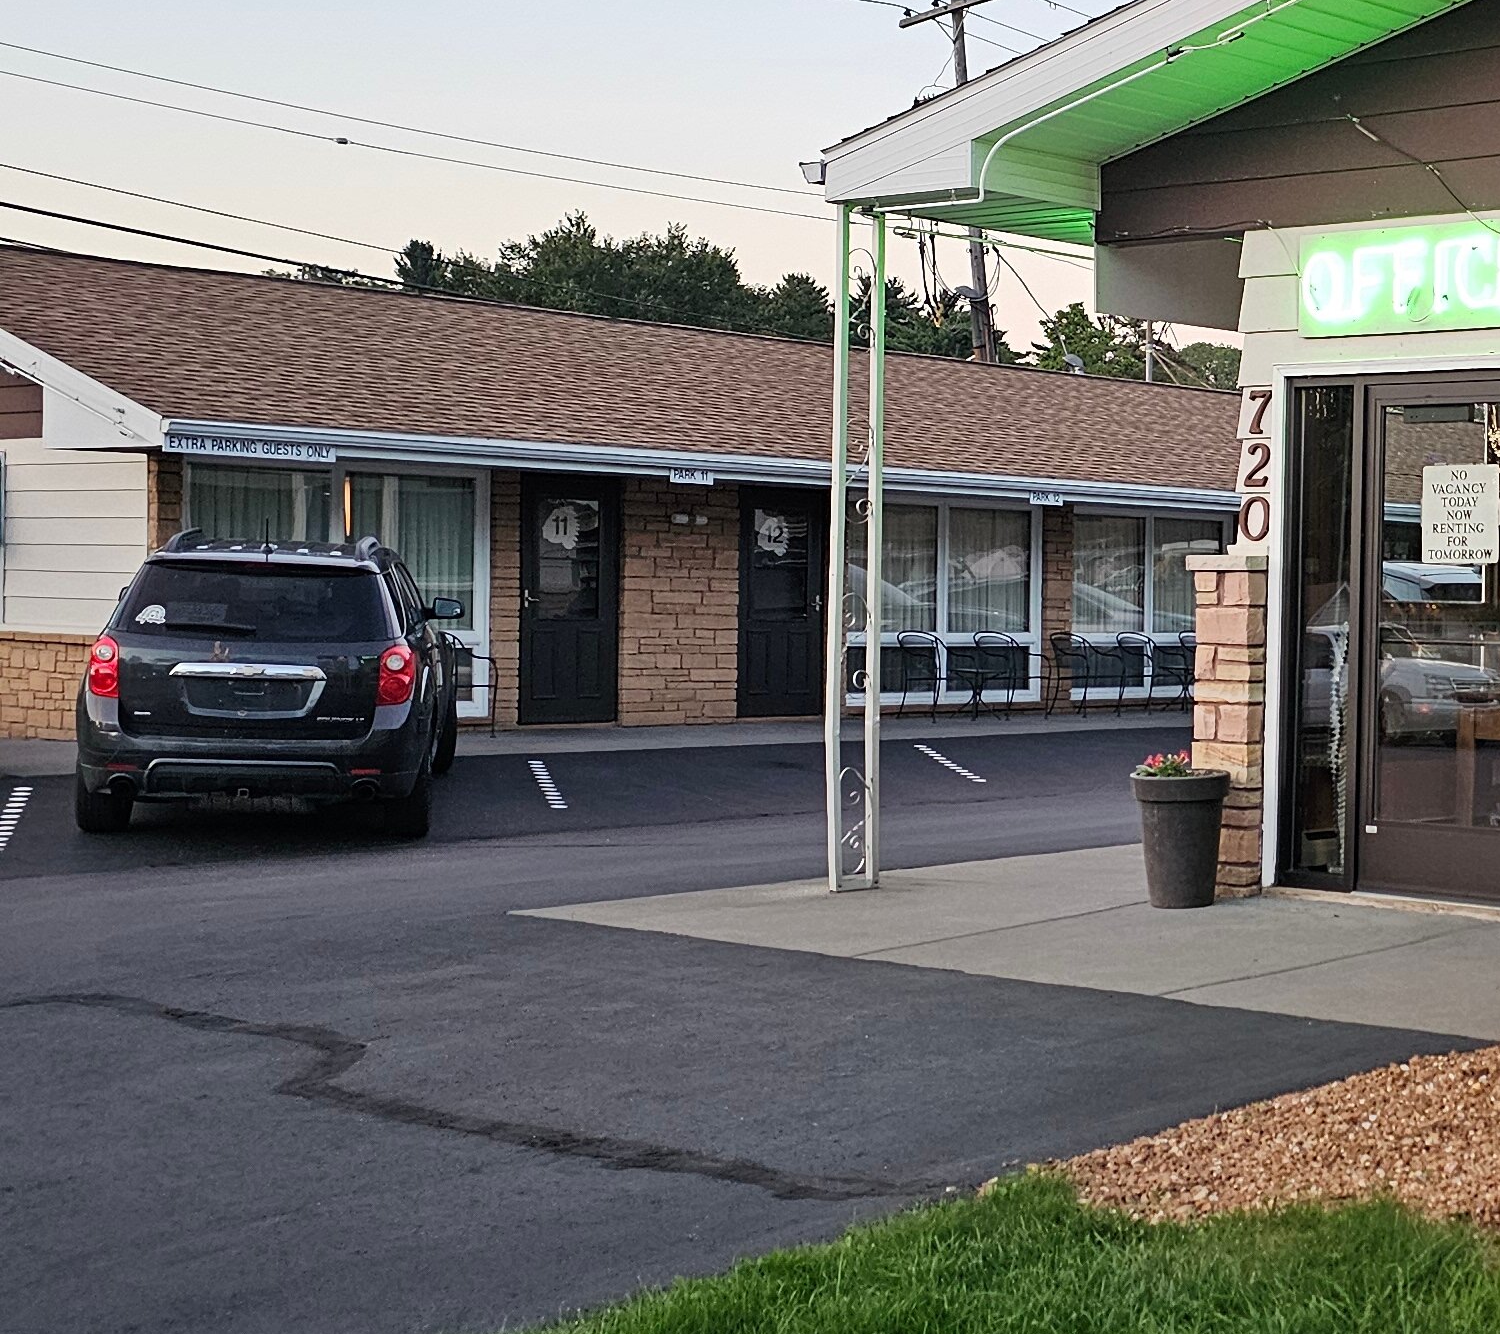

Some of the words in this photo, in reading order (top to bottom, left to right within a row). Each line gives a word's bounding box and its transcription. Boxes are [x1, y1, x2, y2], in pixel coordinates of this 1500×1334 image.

[169, 435, 206, 451] EXTRA
[211, 438, 257, 454] PARKING
[262, 441, 302, 457] GUESTS
[306, 445, 331, 459] ONLY
[1238, 389, 1273, 542] 720
[673, 468, 697, 480] PARK
[700, 470, 709, 481] 11
[1450, 470, 1468, 481] NO
[1431, 482, 1487, 495] VACANCY
[1032, 491, 1050, 501] PARK
[1053, 492, 1061, 503] 12
[1441, 496, 1479, 507] TODAY
[1446, 509, 1473, 521] NOW
[552, 515, 568, 536] 11
[1432, 523, 1485, 534] RENTING
[765, 525, 784, 544] 12
[1446, 536, 1468, 547] FOR
[1428, 549, 1493, 560] TOMORROW
